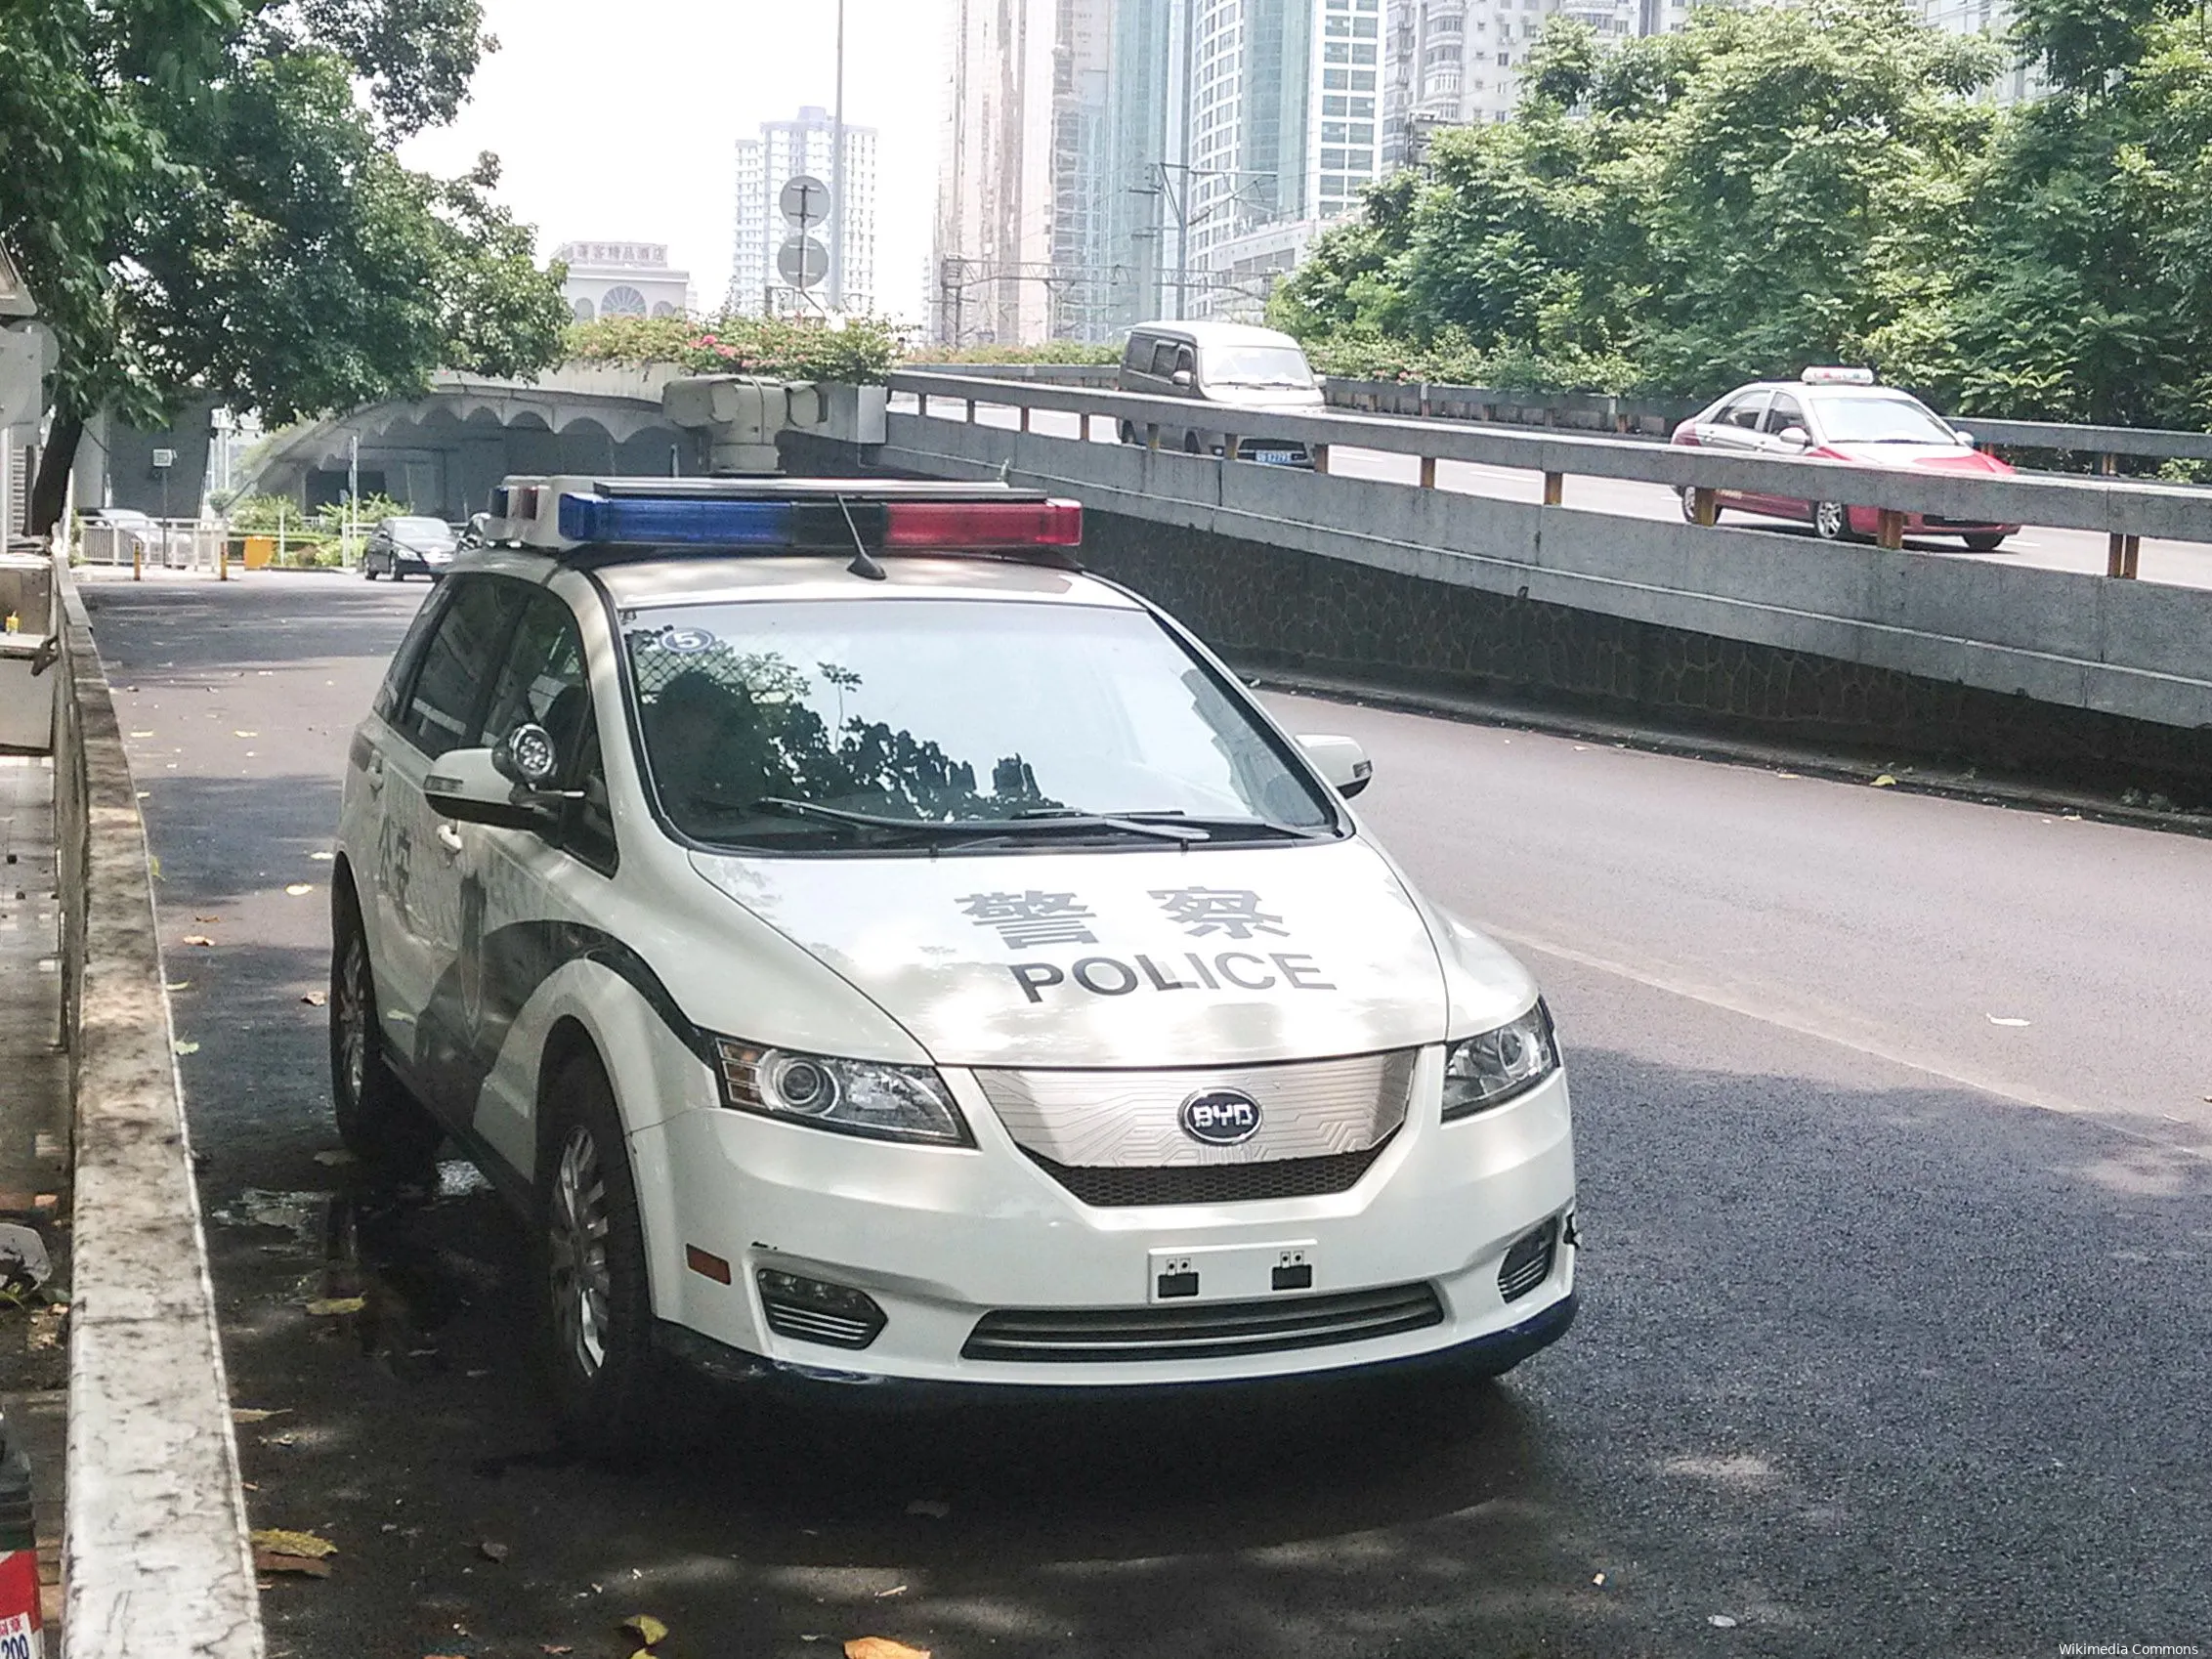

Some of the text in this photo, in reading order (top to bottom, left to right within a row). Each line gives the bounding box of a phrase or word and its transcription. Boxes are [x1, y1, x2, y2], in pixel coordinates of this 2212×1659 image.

[673, 631, 702, 649] 5
[954, 886, 1292, 950] 警察
[1007, 952, 1338, 1003] POLICE
[1193, 1103, 1254, 1127] BYD
